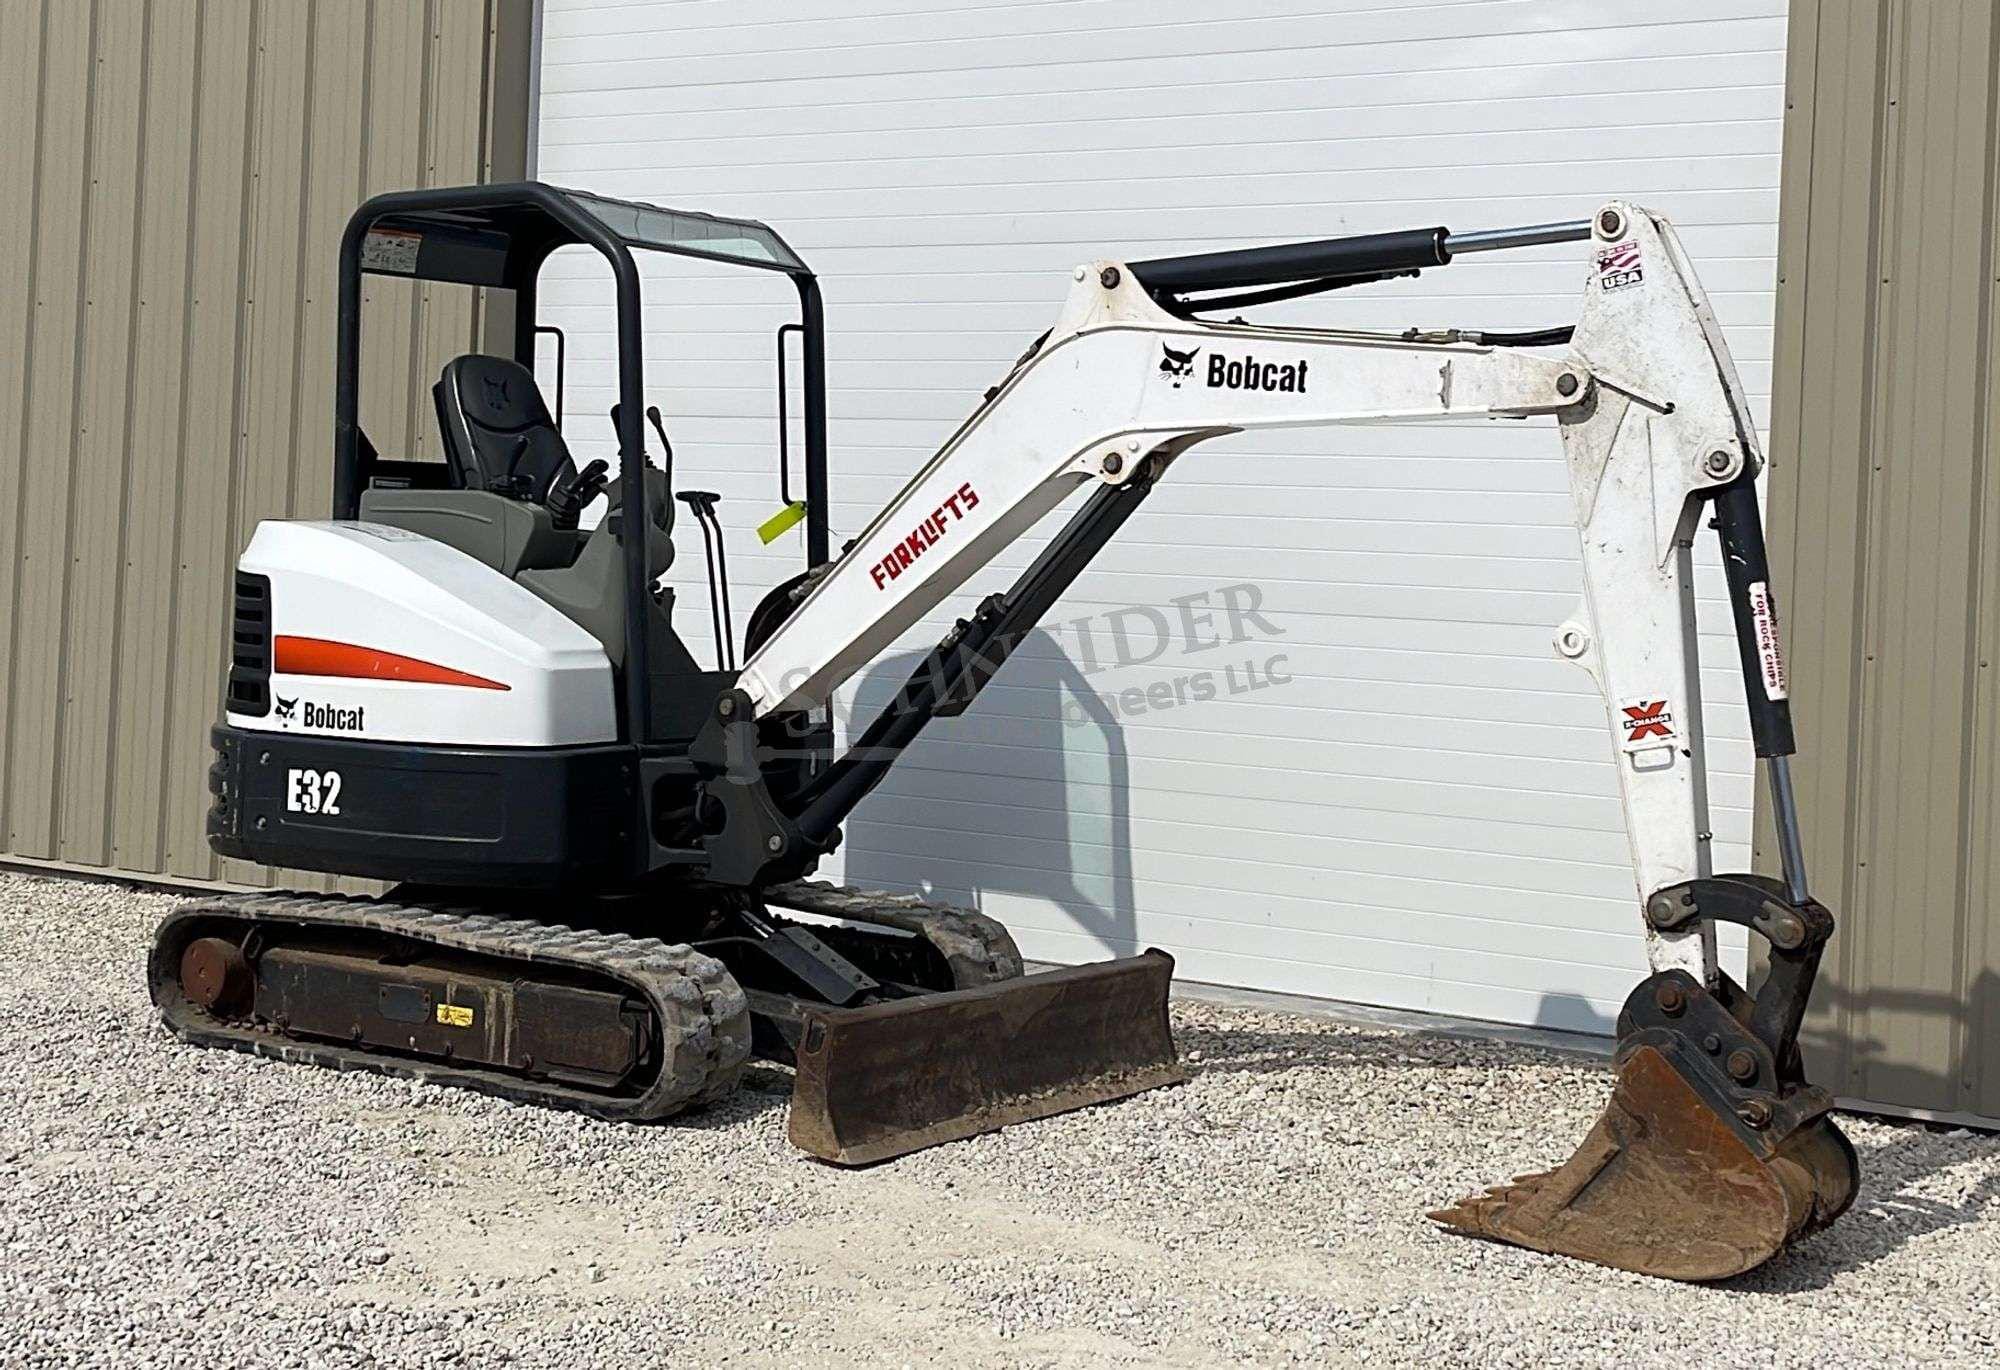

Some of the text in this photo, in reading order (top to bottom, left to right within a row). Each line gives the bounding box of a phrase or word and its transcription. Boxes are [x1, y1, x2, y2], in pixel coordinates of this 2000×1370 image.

[1603, 271, 1642, 288] USA
[1207, 353, 1308, 393] Bobcat
[869, 482, 980, 591] FORKLIFTS
[1755, 594, 1778, 688] FOR ROCK CHIPS
[304, 702, 364, 731] Bobcat
[287, 768, 341, 815] E32
